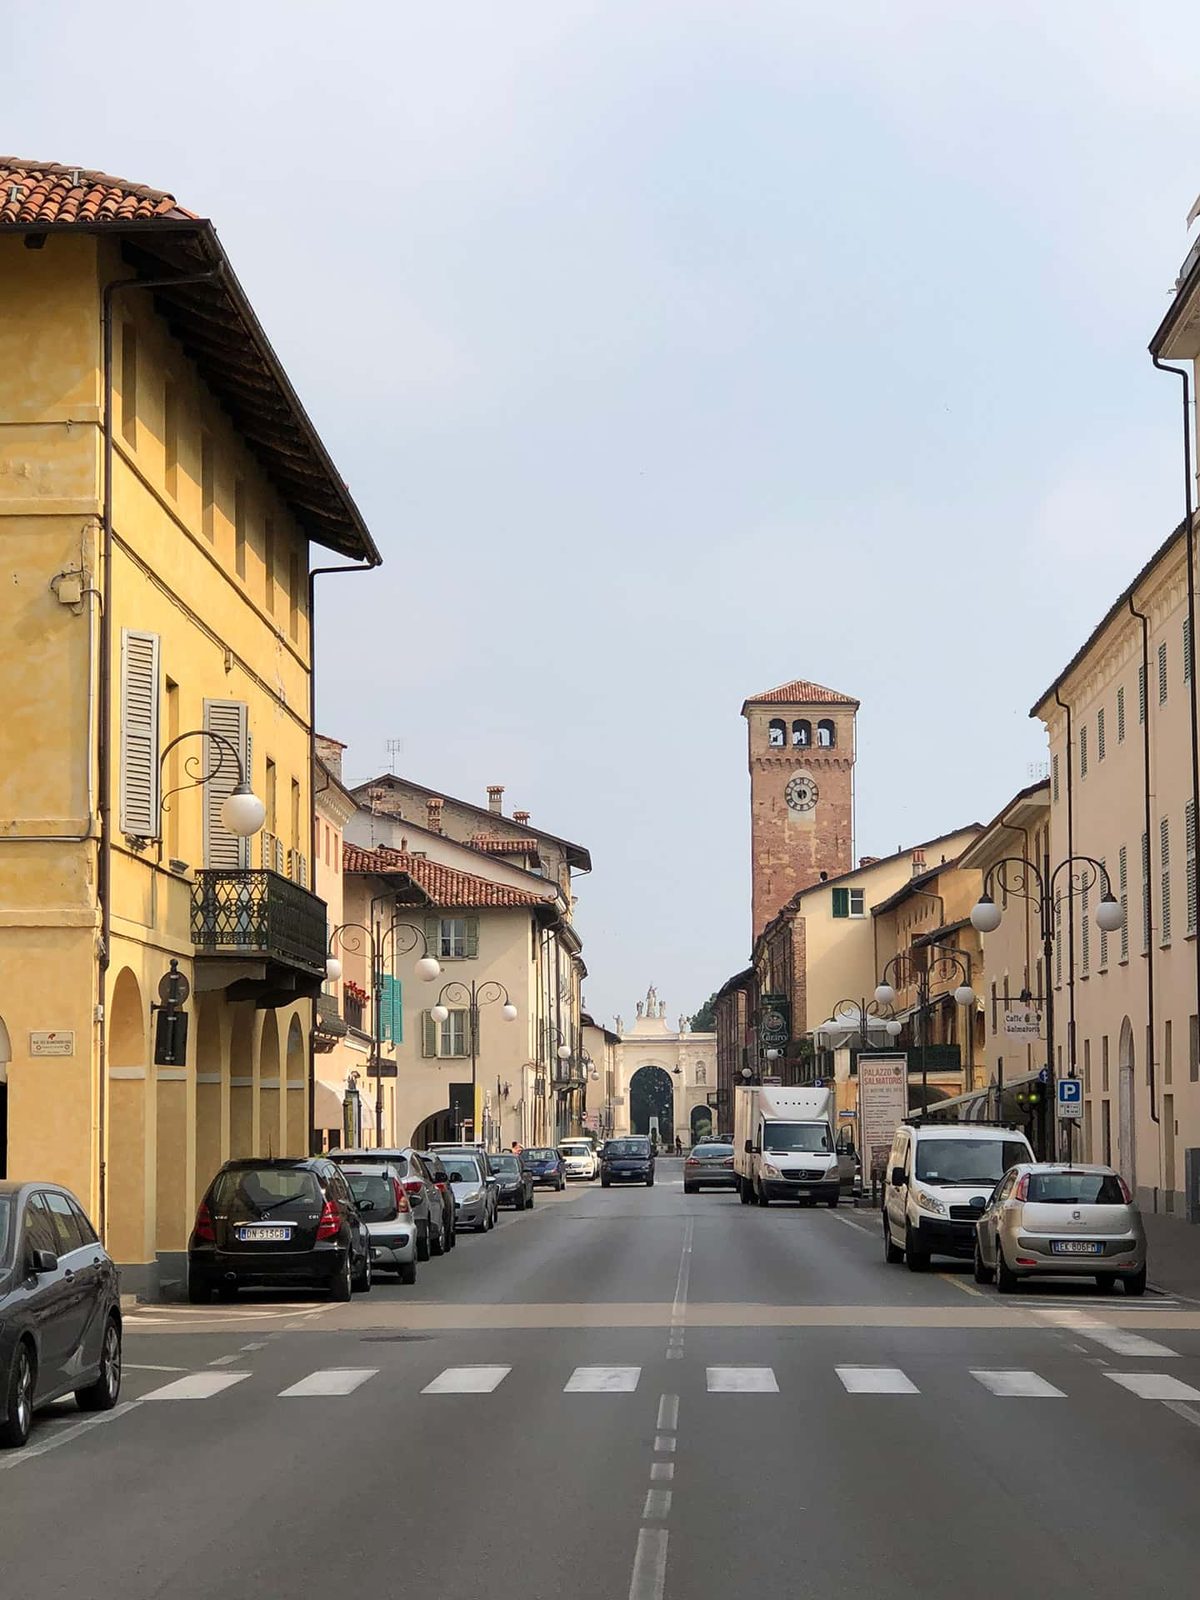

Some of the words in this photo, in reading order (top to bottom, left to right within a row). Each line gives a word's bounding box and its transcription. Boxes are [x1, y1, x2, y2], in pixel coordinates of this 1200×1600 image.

[864, 1067, 893, 1077] PALAZZO
[864, 1076, 903, 1085] SALMATORIS
[1063, 1084, 1076, 1100] P
[246, 1229, 257, 1239] DN
